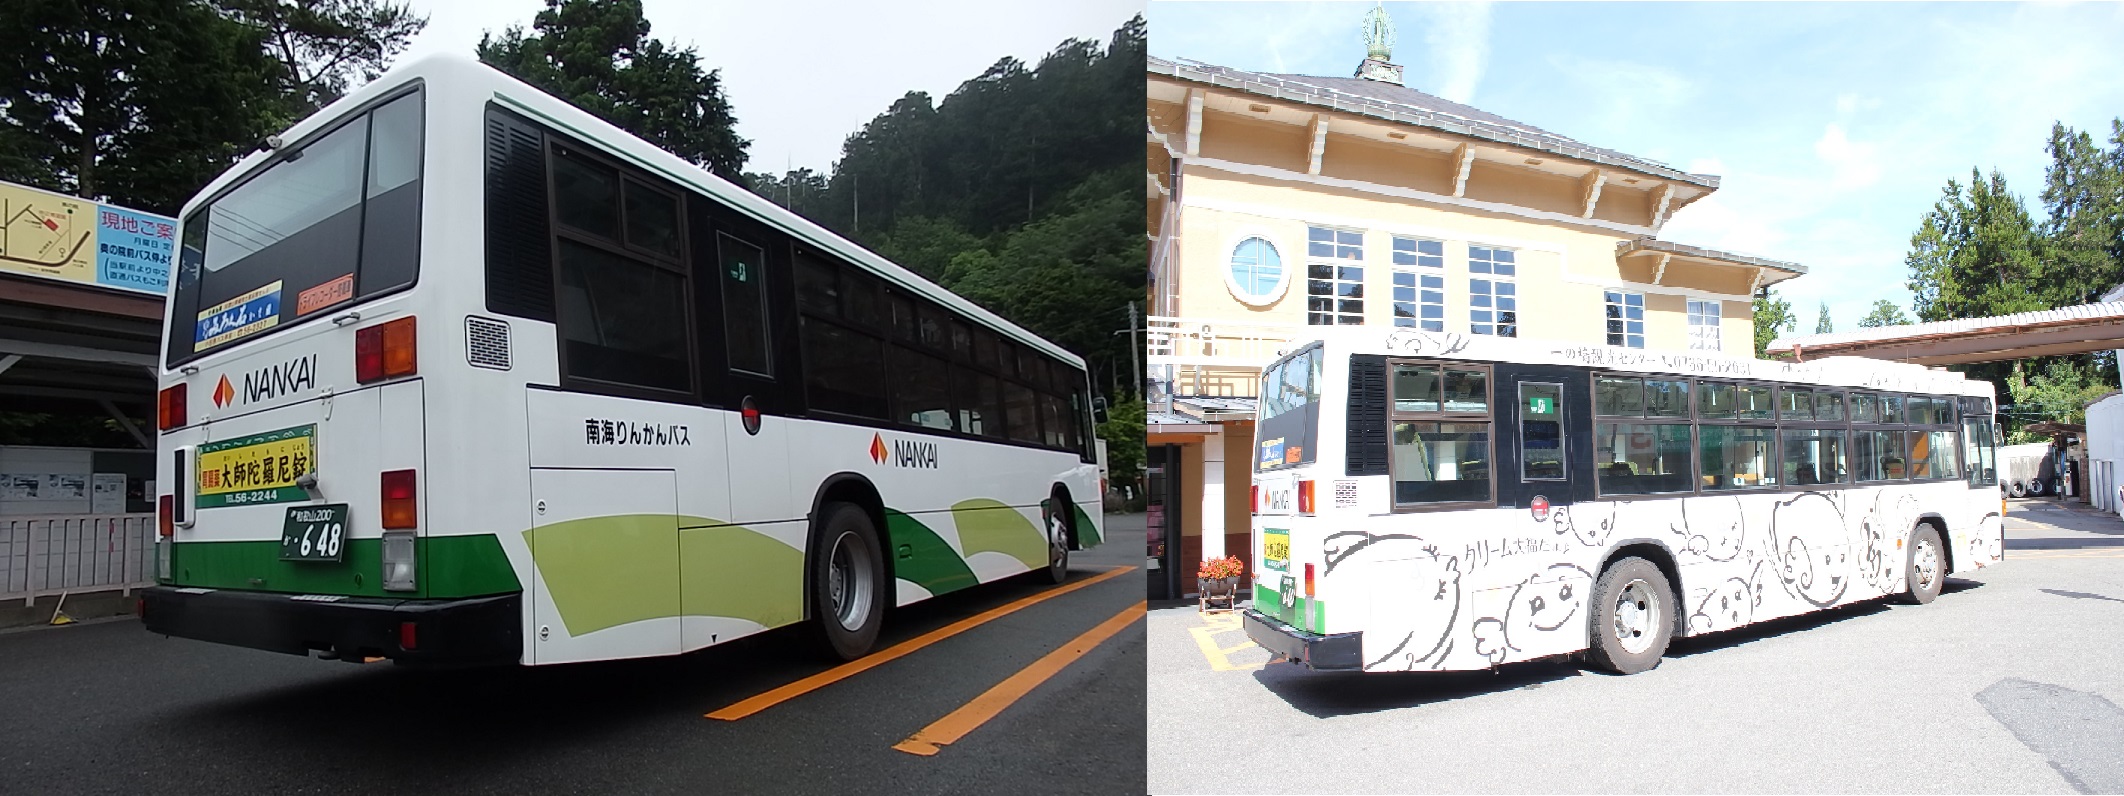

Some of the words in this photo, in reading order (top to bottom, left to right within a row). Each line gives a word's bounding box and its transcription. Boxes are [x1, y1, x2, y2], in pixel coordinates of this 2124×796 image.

[102, 211, 176, 240] 現地ご案
[243, 354, 316, 405] NANKAI
[585, 418, 691, 446] 南海りんかんバス
[895, 439, 938, 469] NANKAI
